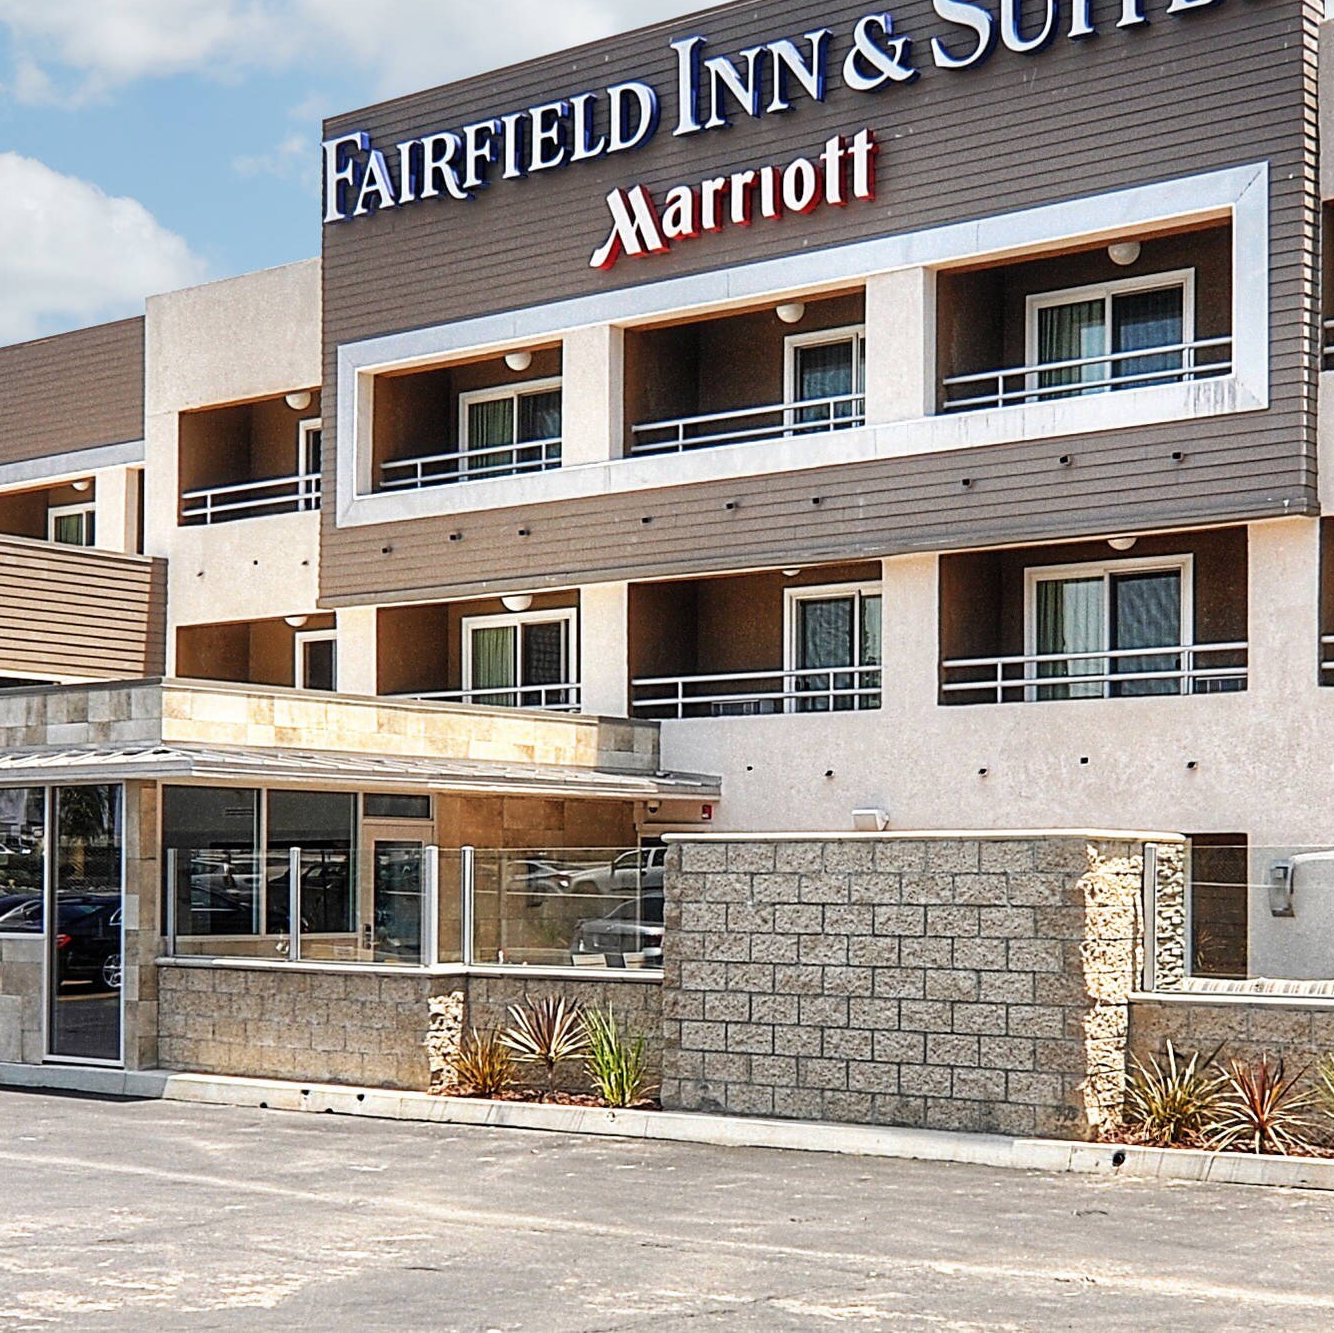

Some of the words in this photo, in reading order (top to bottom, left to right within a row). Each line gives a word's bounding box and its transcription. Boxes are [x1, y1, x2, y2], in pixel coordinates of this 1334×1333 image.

[321, 79, 660, 223] FAIRFIELD
[670, 27, 833, 136] INN
[842, 12, 920, 92] &
[589, 127, 880, 270] Marriott
